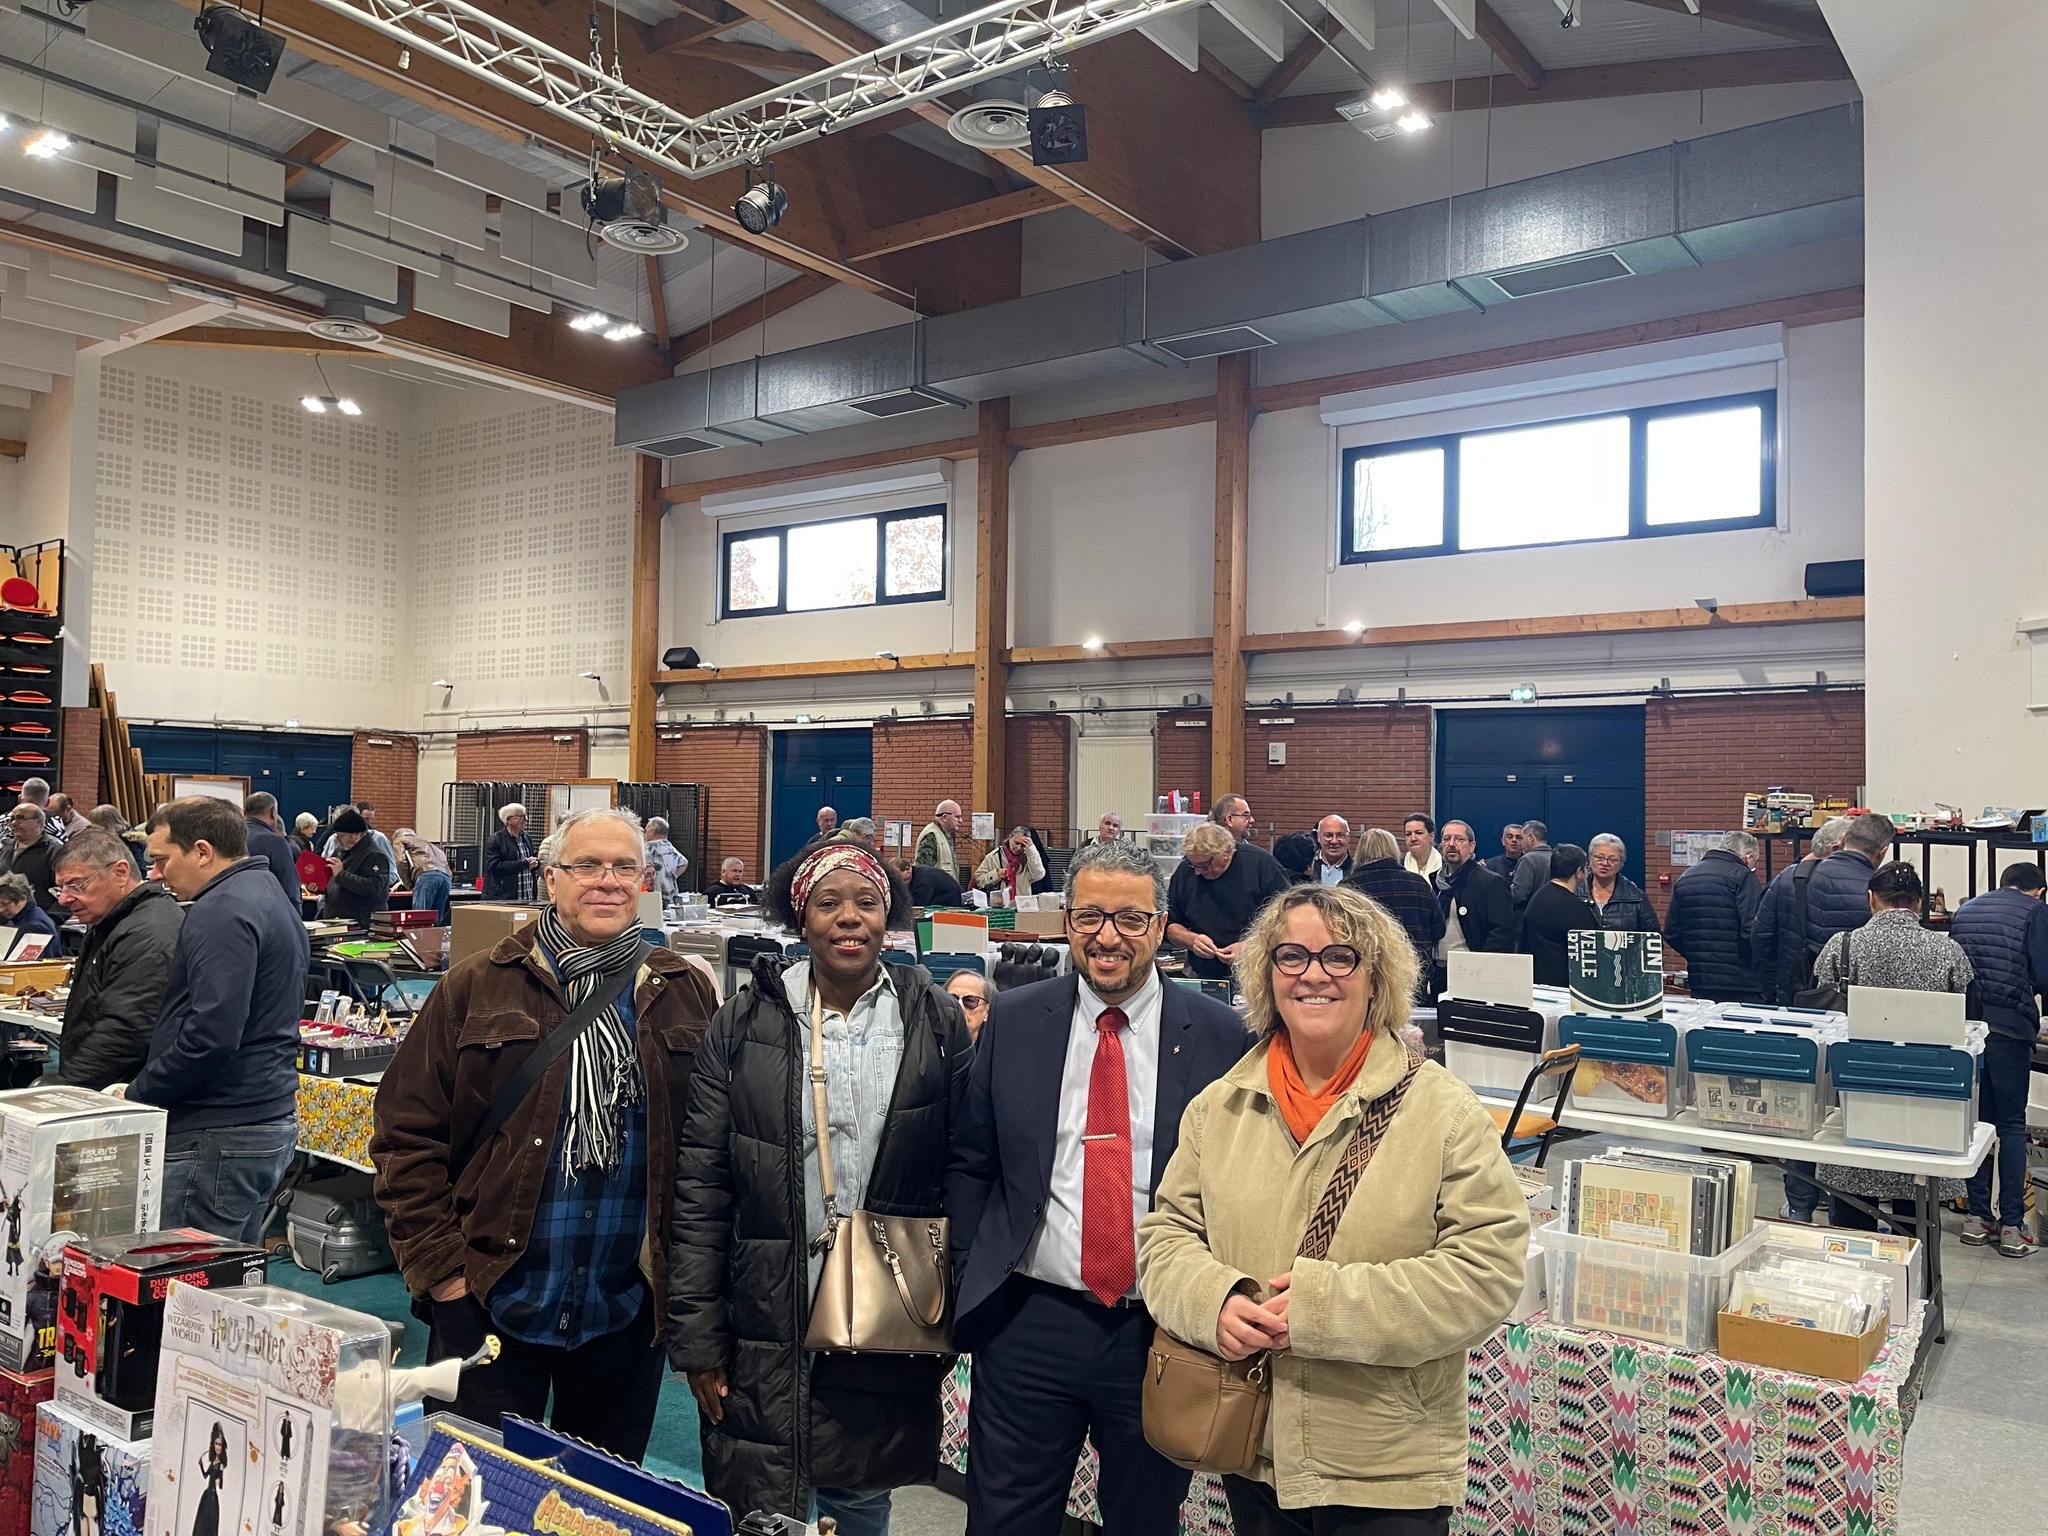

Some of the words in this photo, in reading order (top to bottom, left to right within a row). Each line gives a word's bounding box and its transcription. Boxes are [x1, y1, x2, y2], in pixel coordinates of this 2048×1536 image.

[1646, 932, 1662, 966] UN
[167, 1313, 205, 1333] WIZARDING
[171, 1325, 201, 1344] WORLD
[209, 1310, 245, 1353] Harry
[245, 1315, 286, 1365] Potter
[538, 1494, 631, 1536] MENAGER
